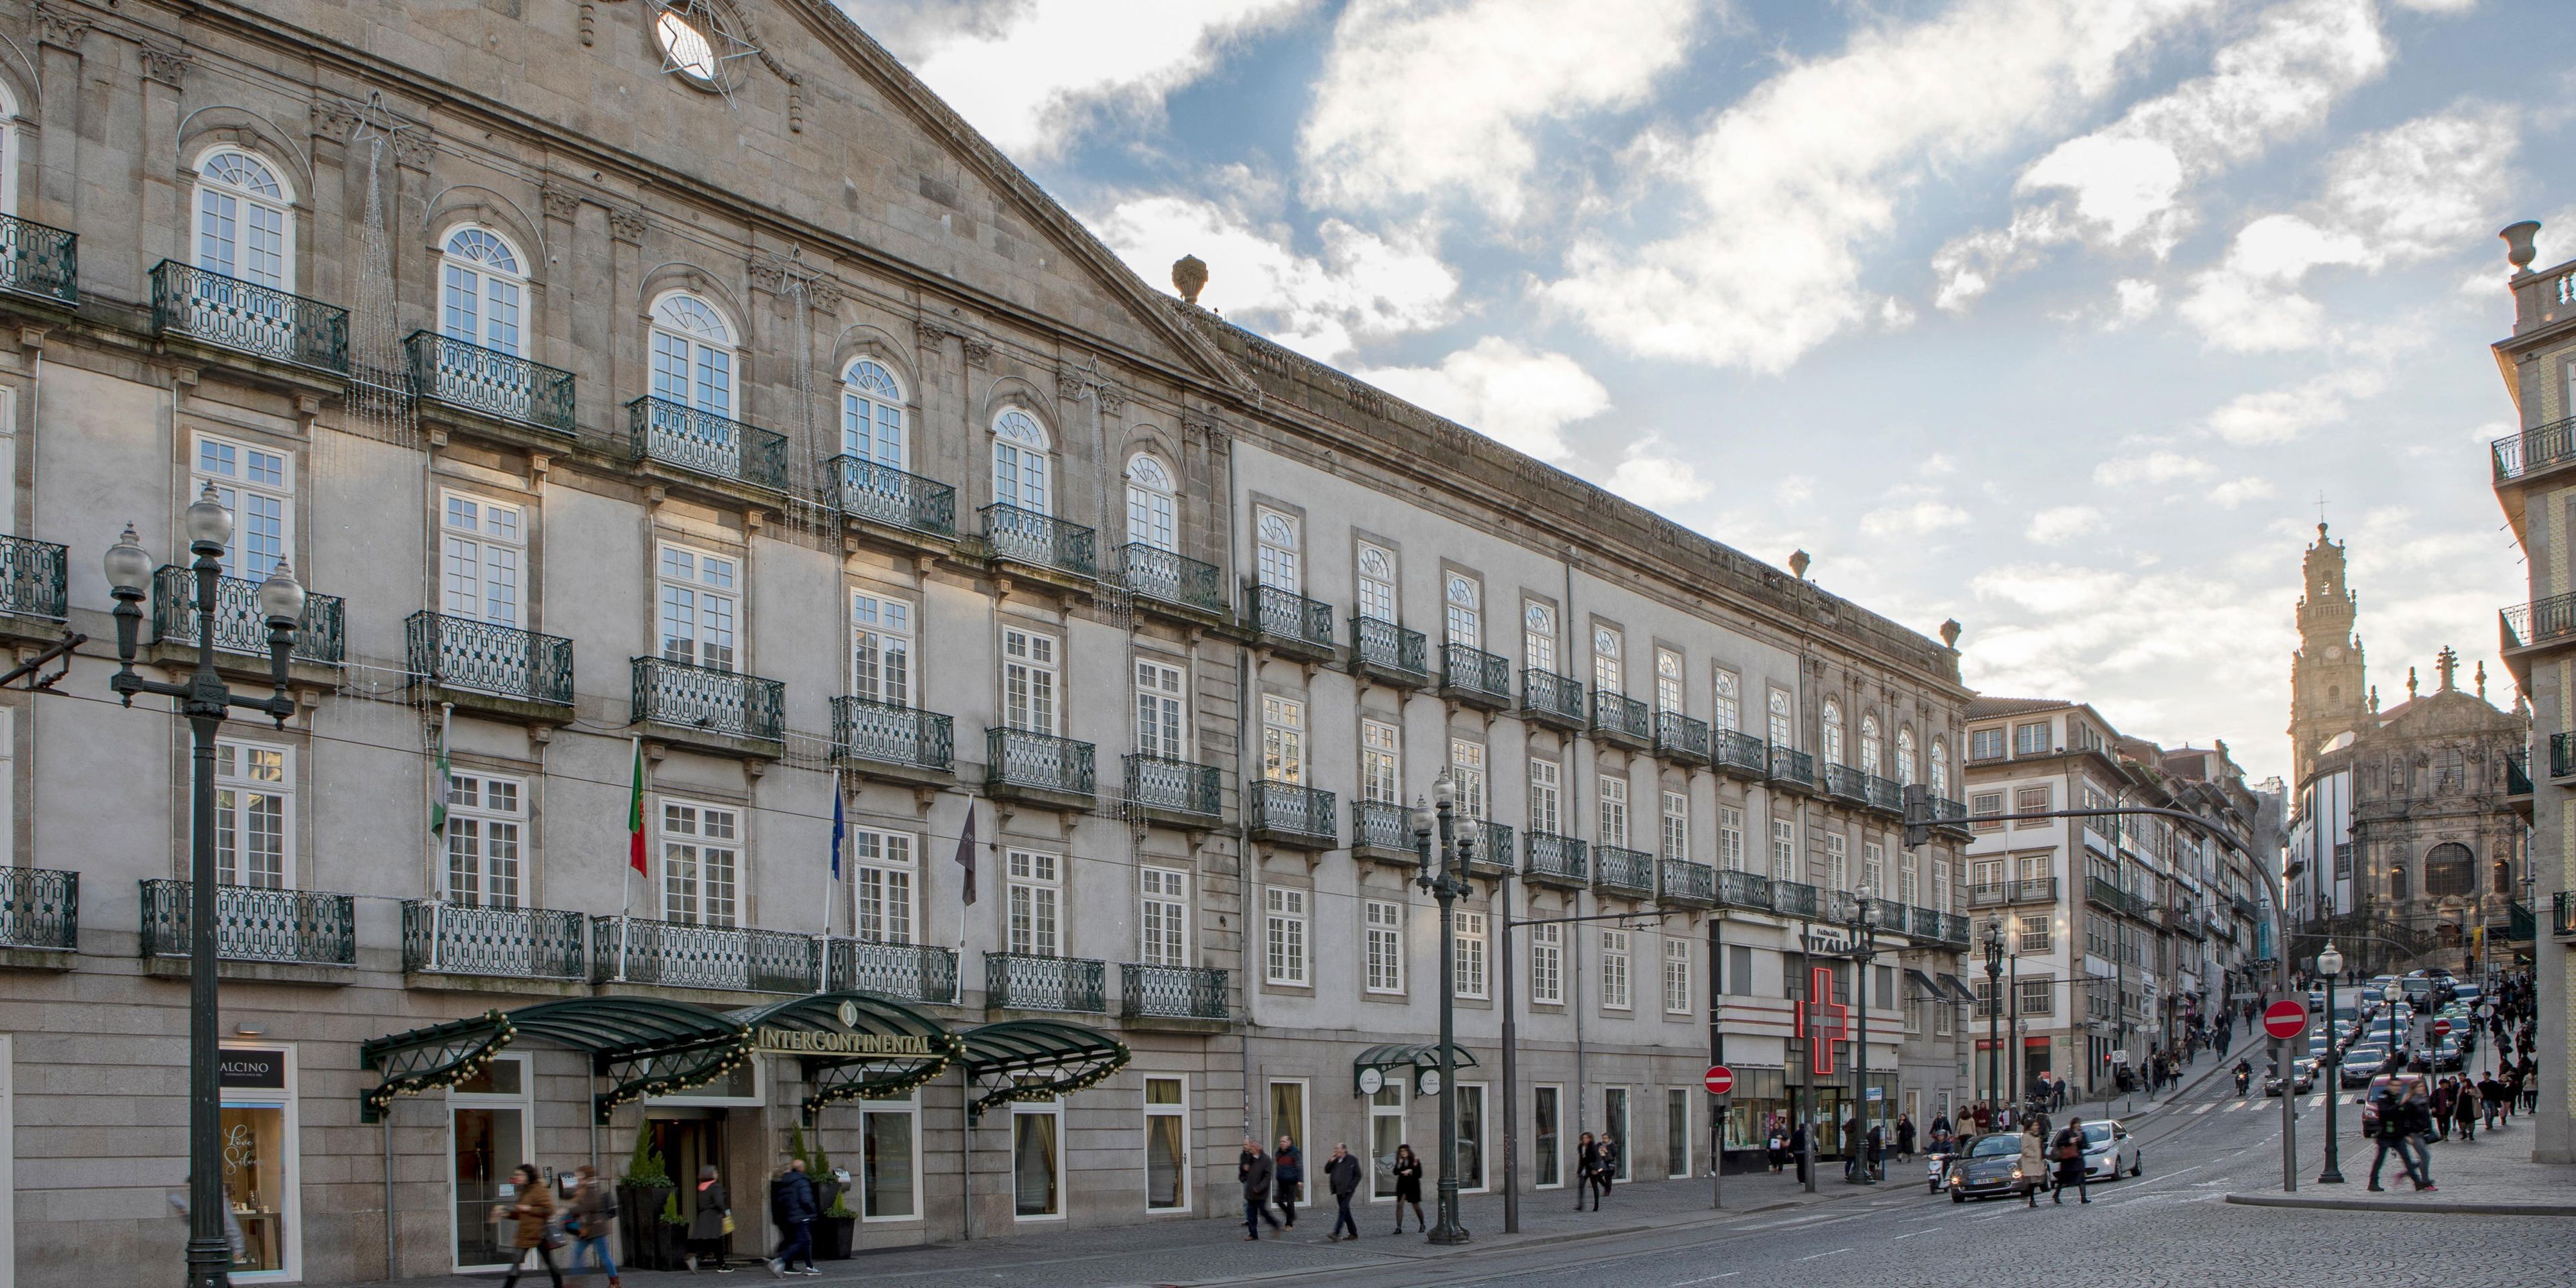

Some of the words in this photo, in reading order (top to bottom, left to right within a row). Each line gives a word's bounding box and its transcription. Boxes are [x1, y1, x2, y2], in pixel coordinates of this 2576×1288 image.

[219, 1062, 268, 1073] ALCINO
[224, 1124, 254, 1148] Love
[224, 1146, 265, 1175] Silver
